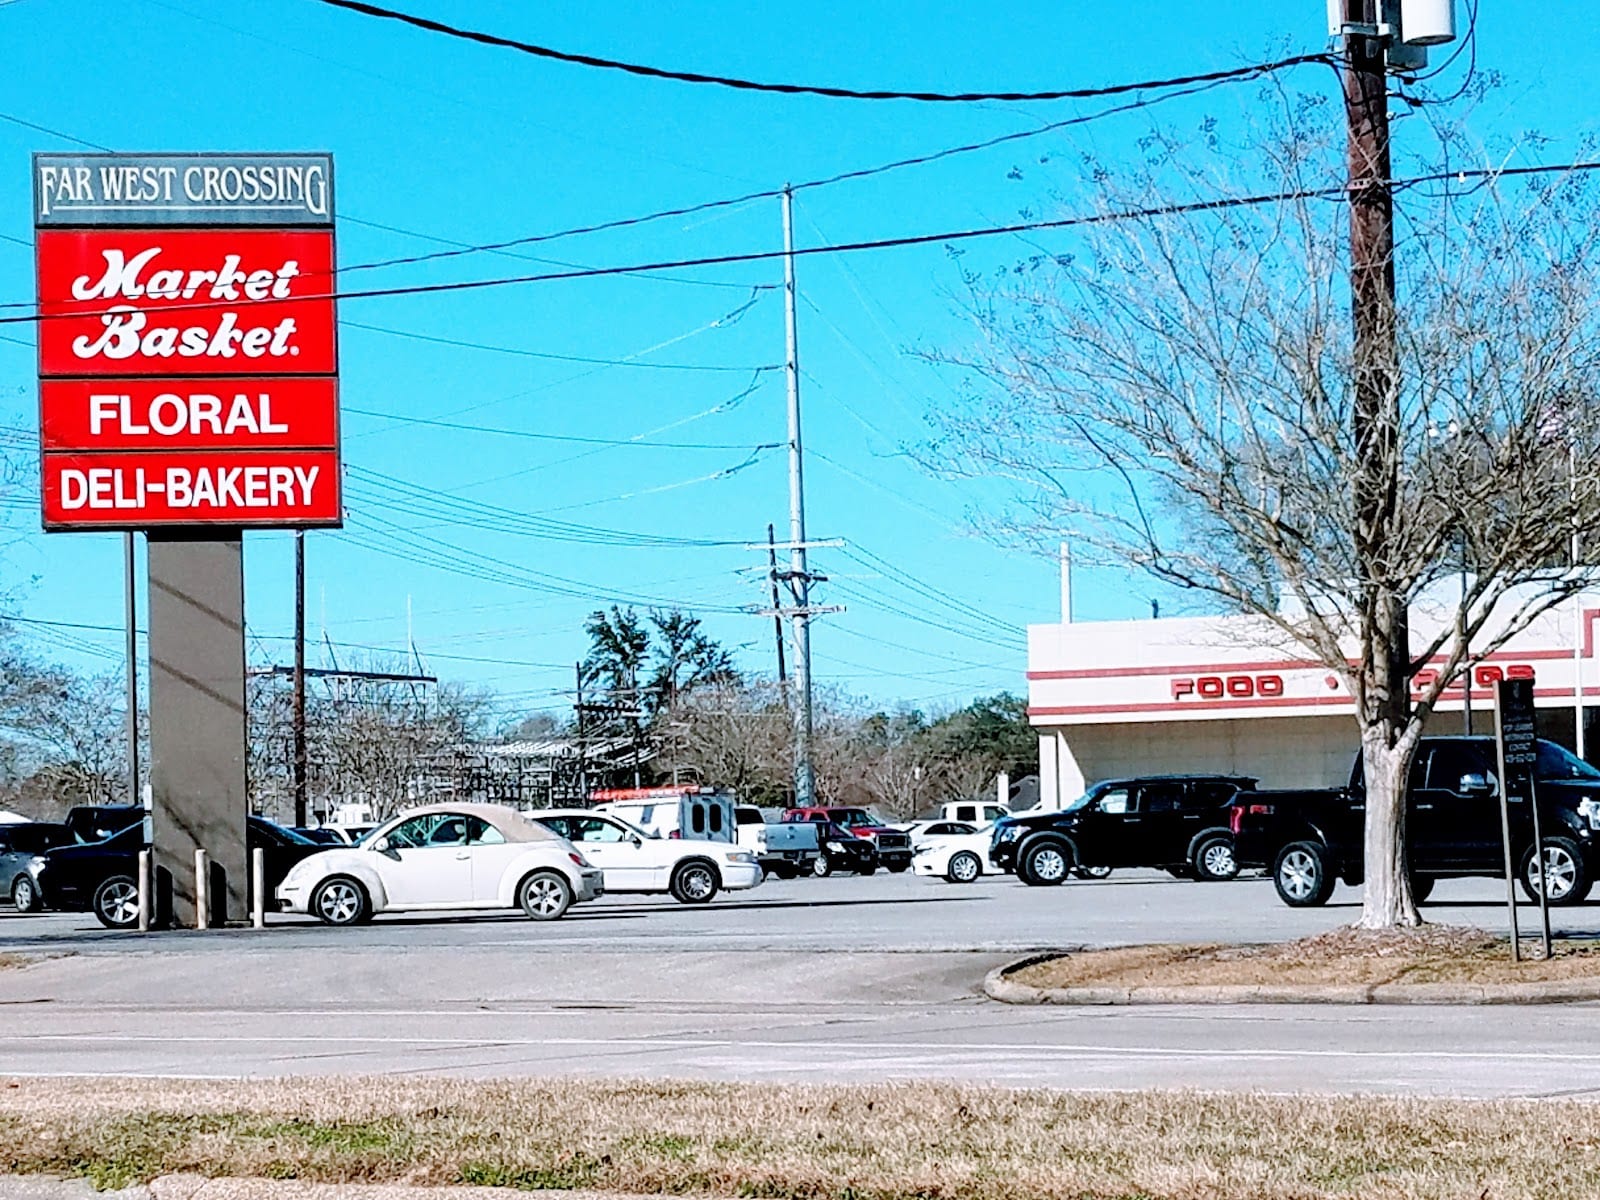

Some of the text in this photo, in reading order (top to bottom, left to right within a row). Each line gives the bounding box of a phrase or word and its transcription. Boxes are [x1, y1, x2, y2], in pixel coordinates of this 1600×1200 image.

[40, 165, 327, 215] FAR WEST CROSSING
[71, 247, 299, 301] Market
[89, 393, 289, 435] FLORAL
[60, 466, 320, 510] DELI-BAKERY
[1171, 675, 1283, 700] FOOD
